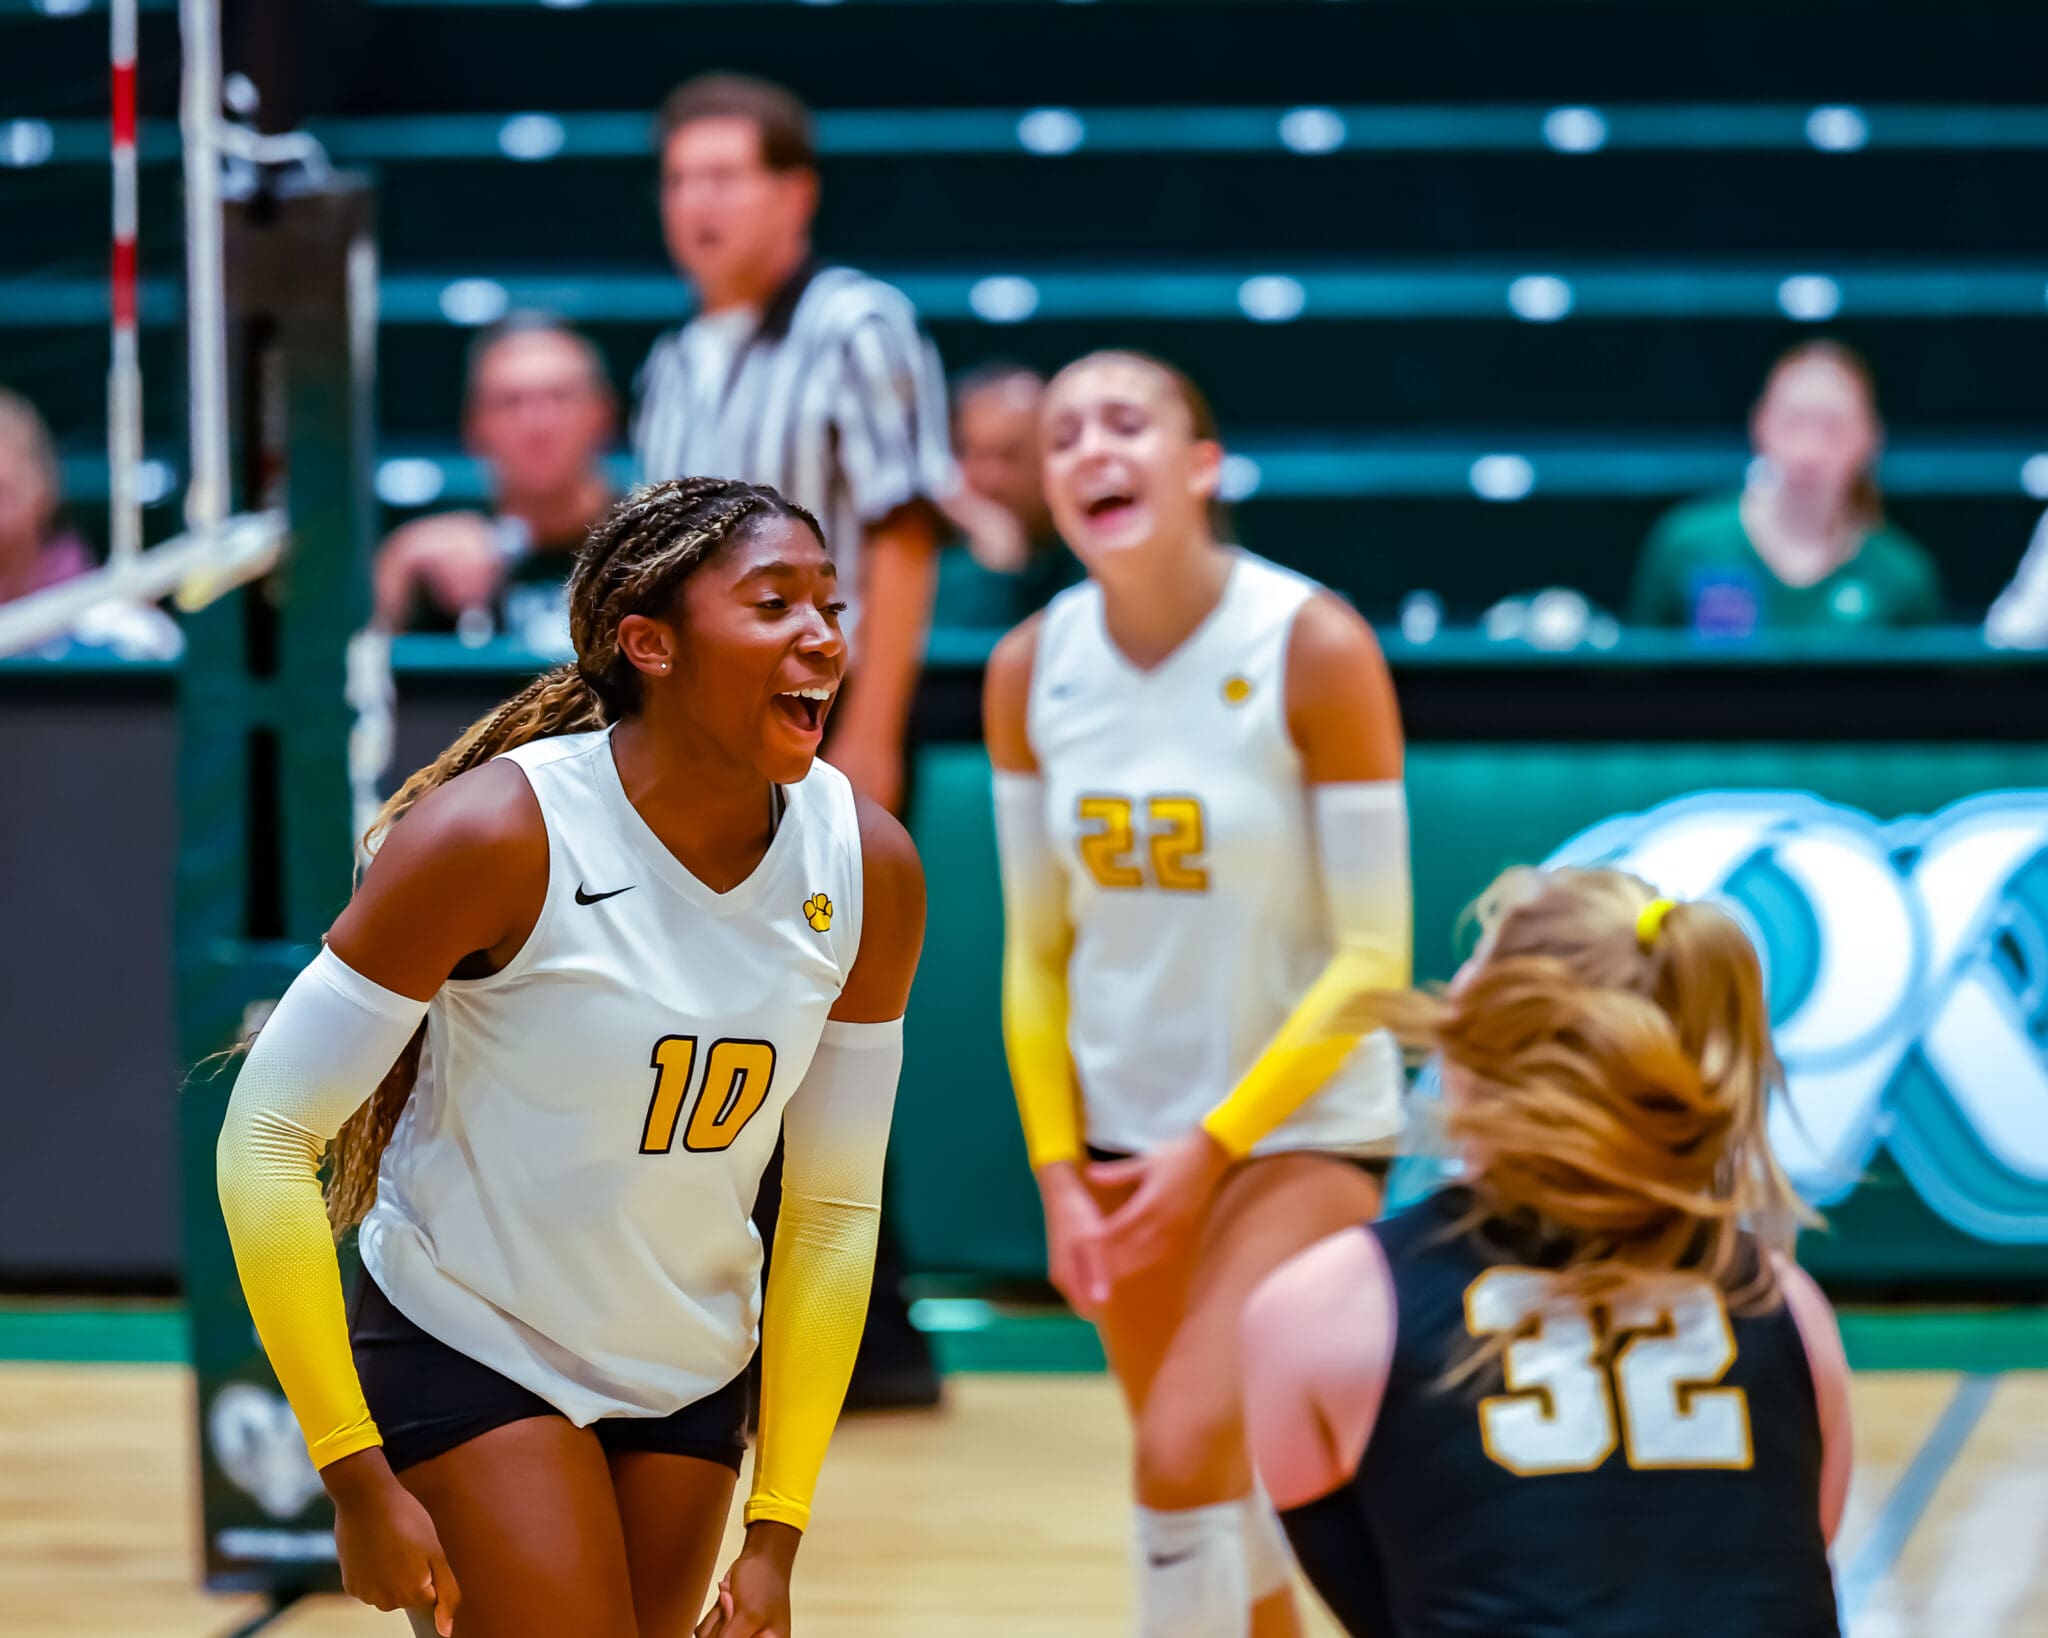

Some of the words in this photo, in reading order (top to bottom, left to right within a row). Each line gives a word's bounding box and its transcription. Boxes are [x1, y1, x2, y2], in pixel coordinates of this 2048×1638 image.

[1074, 793, 1210, 894] 22
[639, 1034, 777, 1154] 10
[1463, 1265, 1754, 1476] 32
